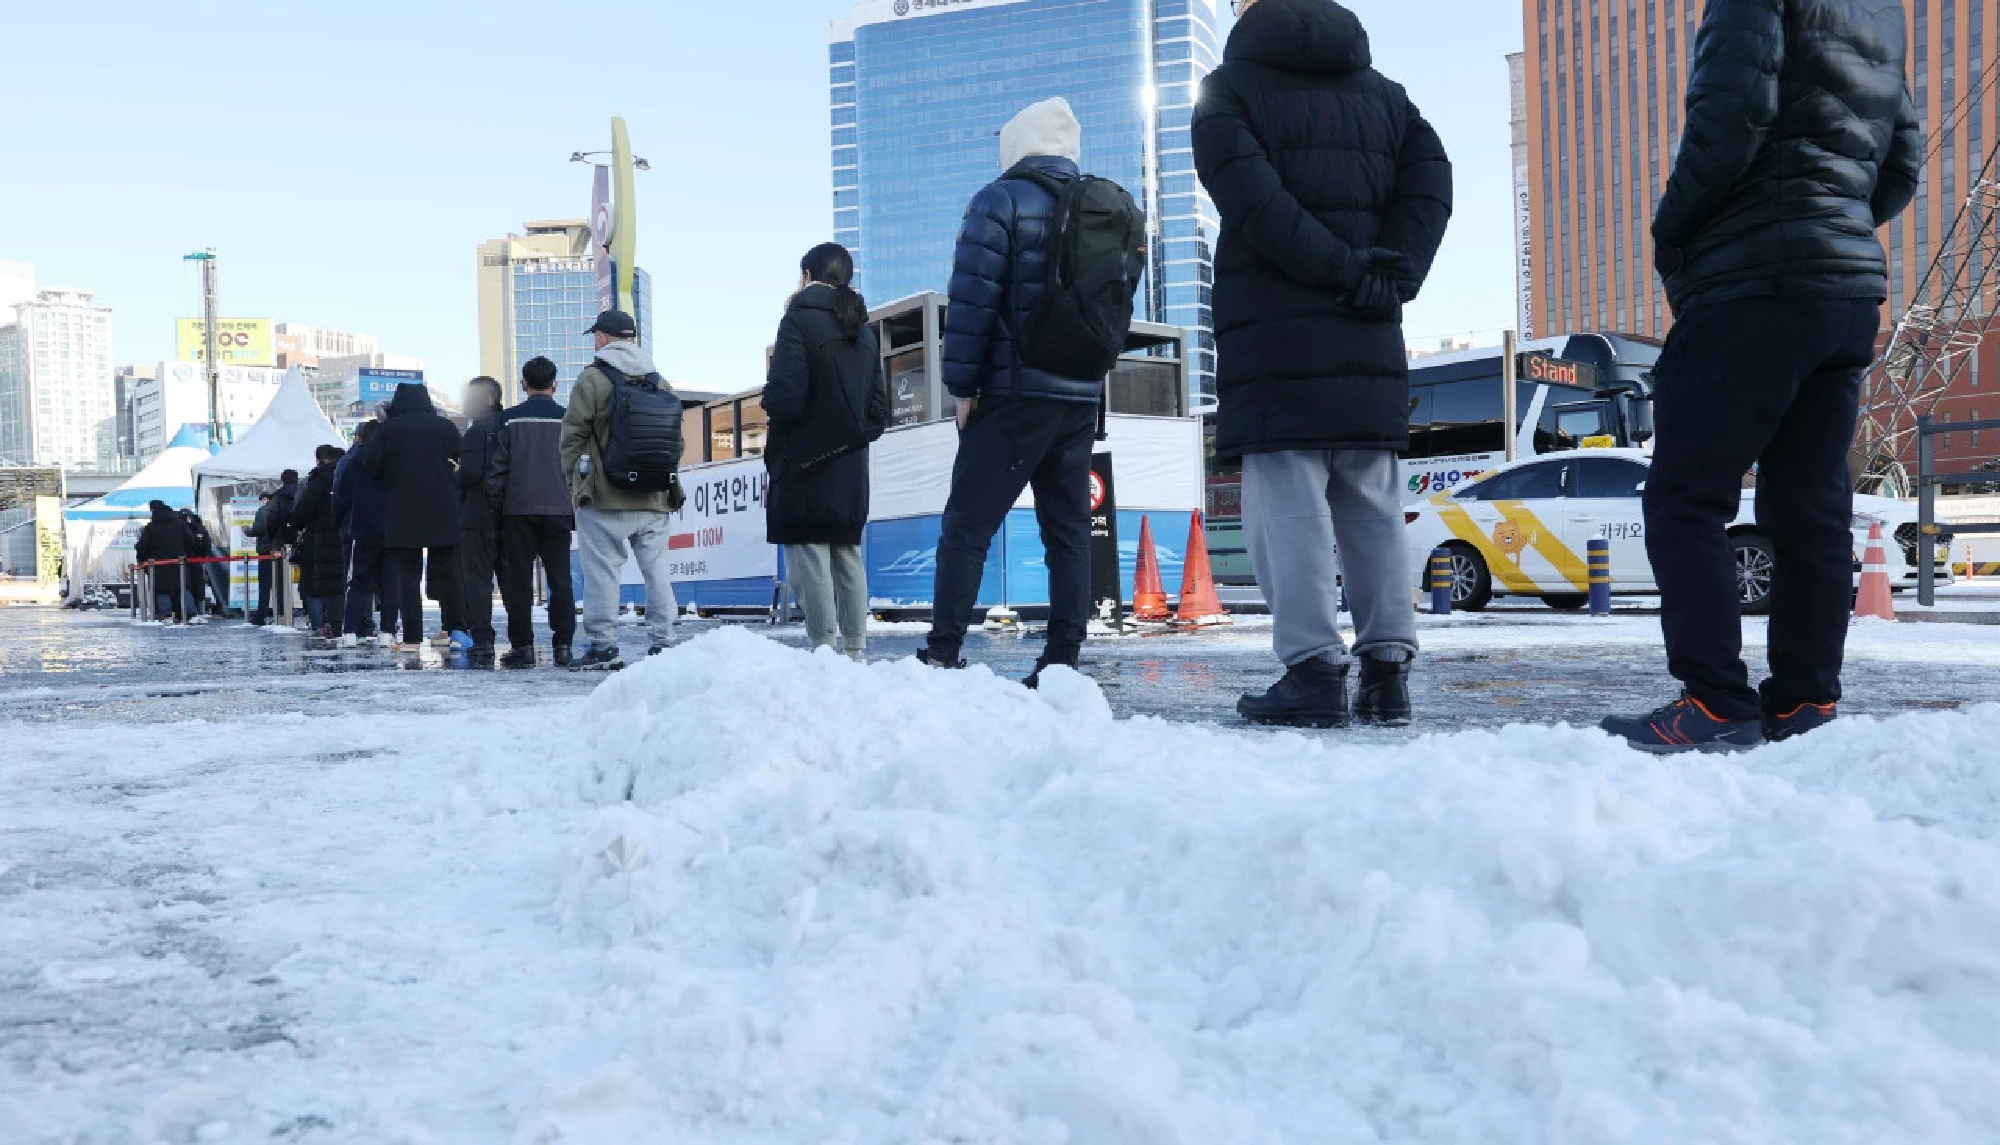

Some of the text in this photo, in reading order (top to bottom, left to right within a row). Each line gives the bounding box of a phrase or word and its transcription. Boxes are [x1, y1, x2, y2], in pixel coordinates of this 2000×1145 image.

[1531, 356, 1578, 384] Stand
[694, 473, 768, 517] 이전안내
[1091, 514, 1107, 526] 구역
[697, 527, 723, 547] 100M
[1090, 528, 1109, 537] oking
[1599, 523, 1643, 539] 카카오
